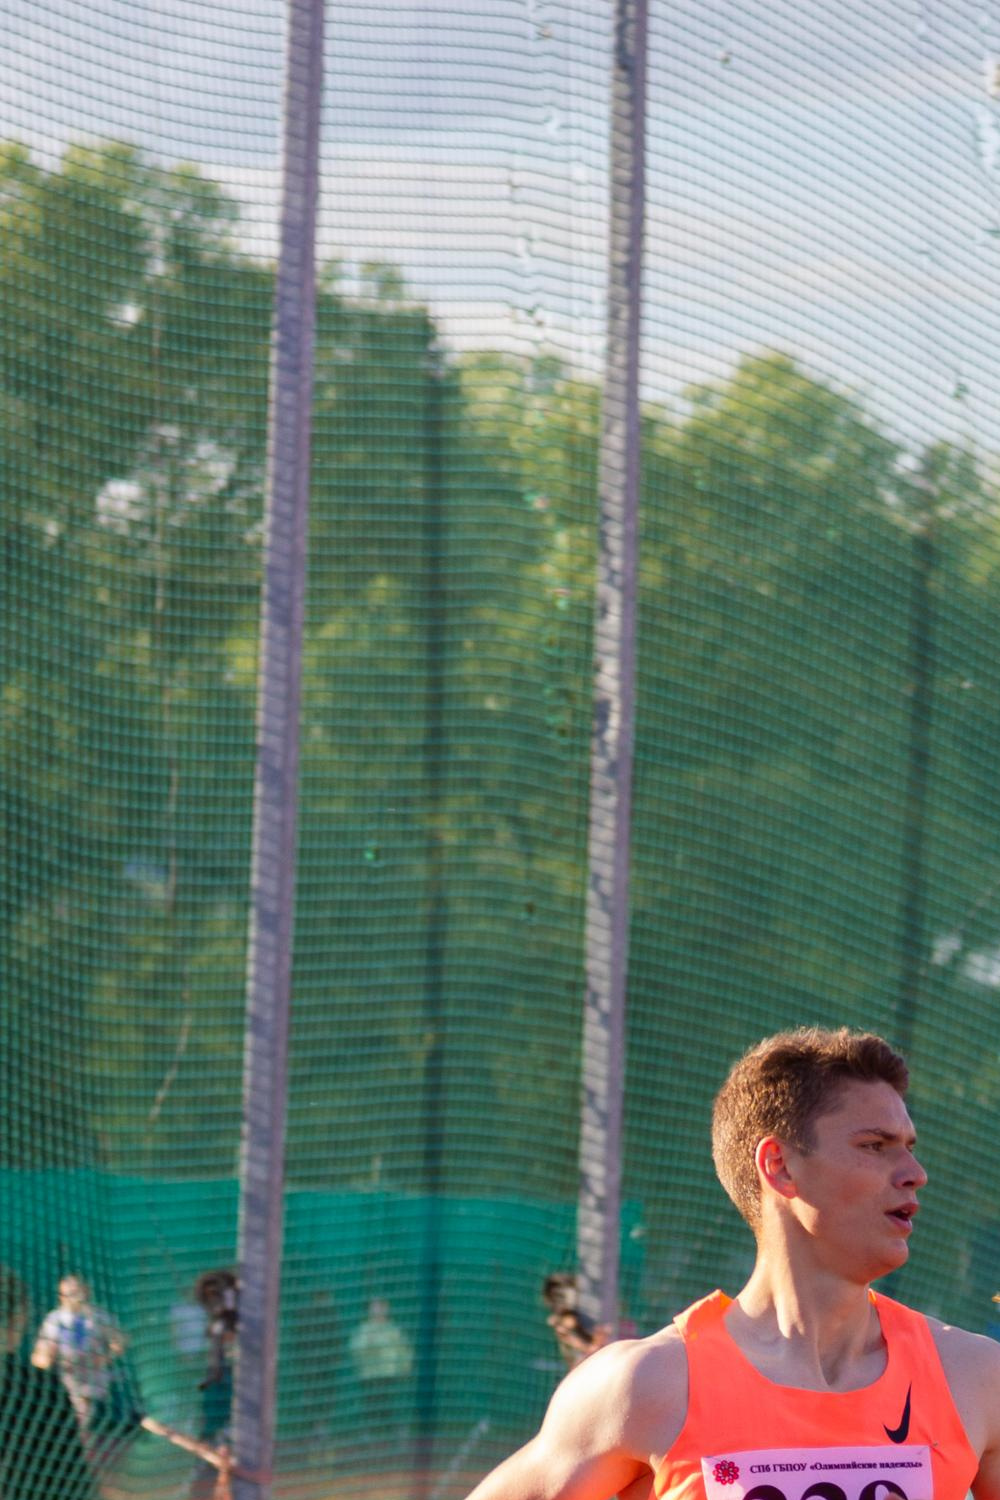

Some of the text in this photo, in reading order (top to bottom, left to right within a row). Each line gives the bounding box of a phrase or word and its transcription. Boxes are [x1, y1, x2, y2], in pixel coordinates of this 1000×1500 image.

[750, 1464, 771, 1474] СПб
[773, 1462, 807, 1473] ГБПОУ
[810, 1460, 878, 1471] «Олимпийские
